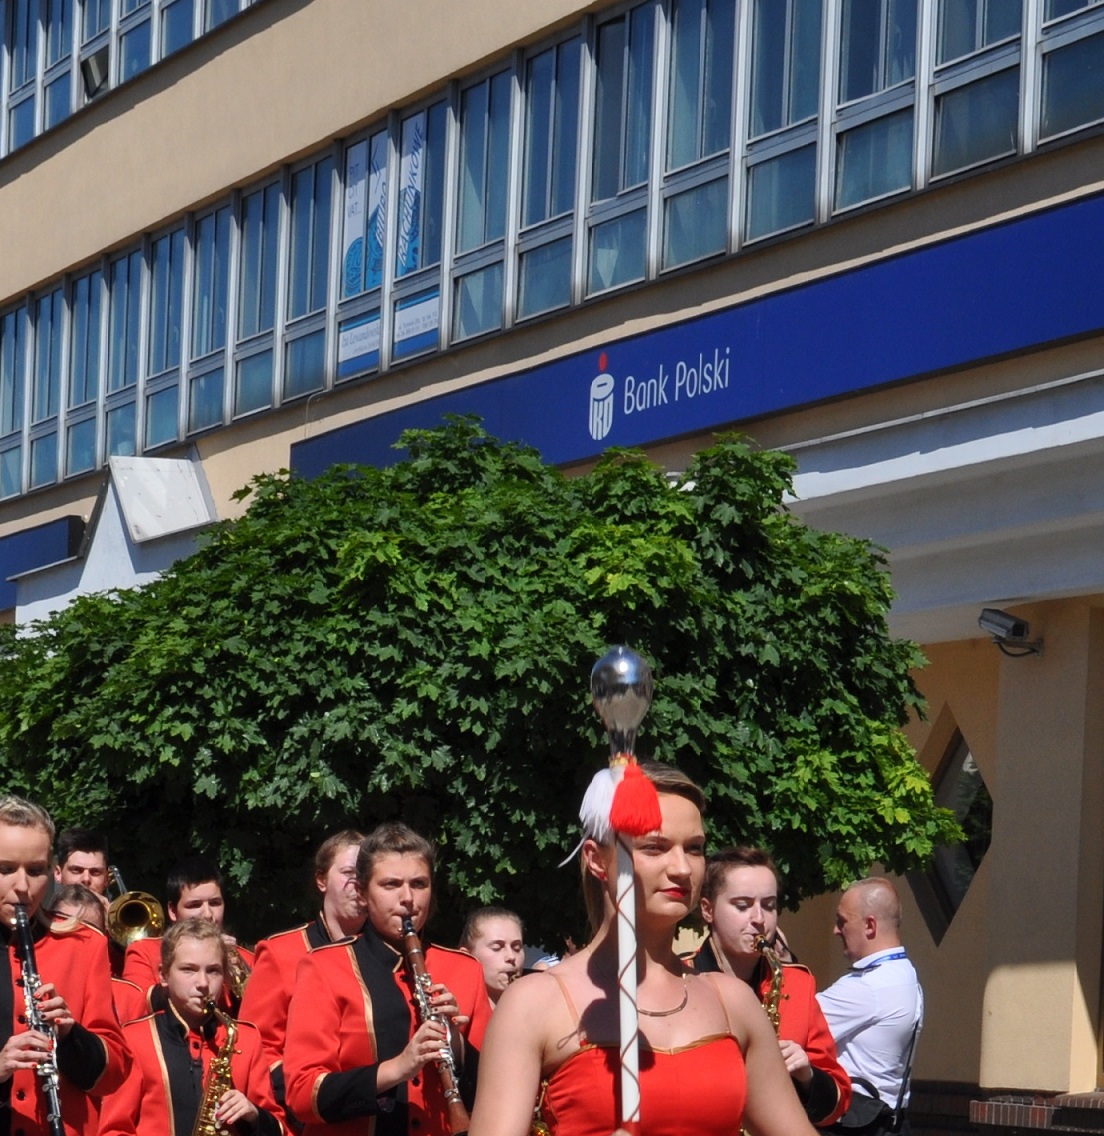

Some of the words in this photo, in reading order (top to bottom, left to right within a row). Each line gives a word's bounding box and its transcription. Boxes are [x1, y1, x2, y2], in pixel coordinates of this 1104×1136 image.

[398, 122, 424, 267] RACHUNKOWE
[623, 364, 669, 415] Bank
[675, 346, 731, 402] Polski
